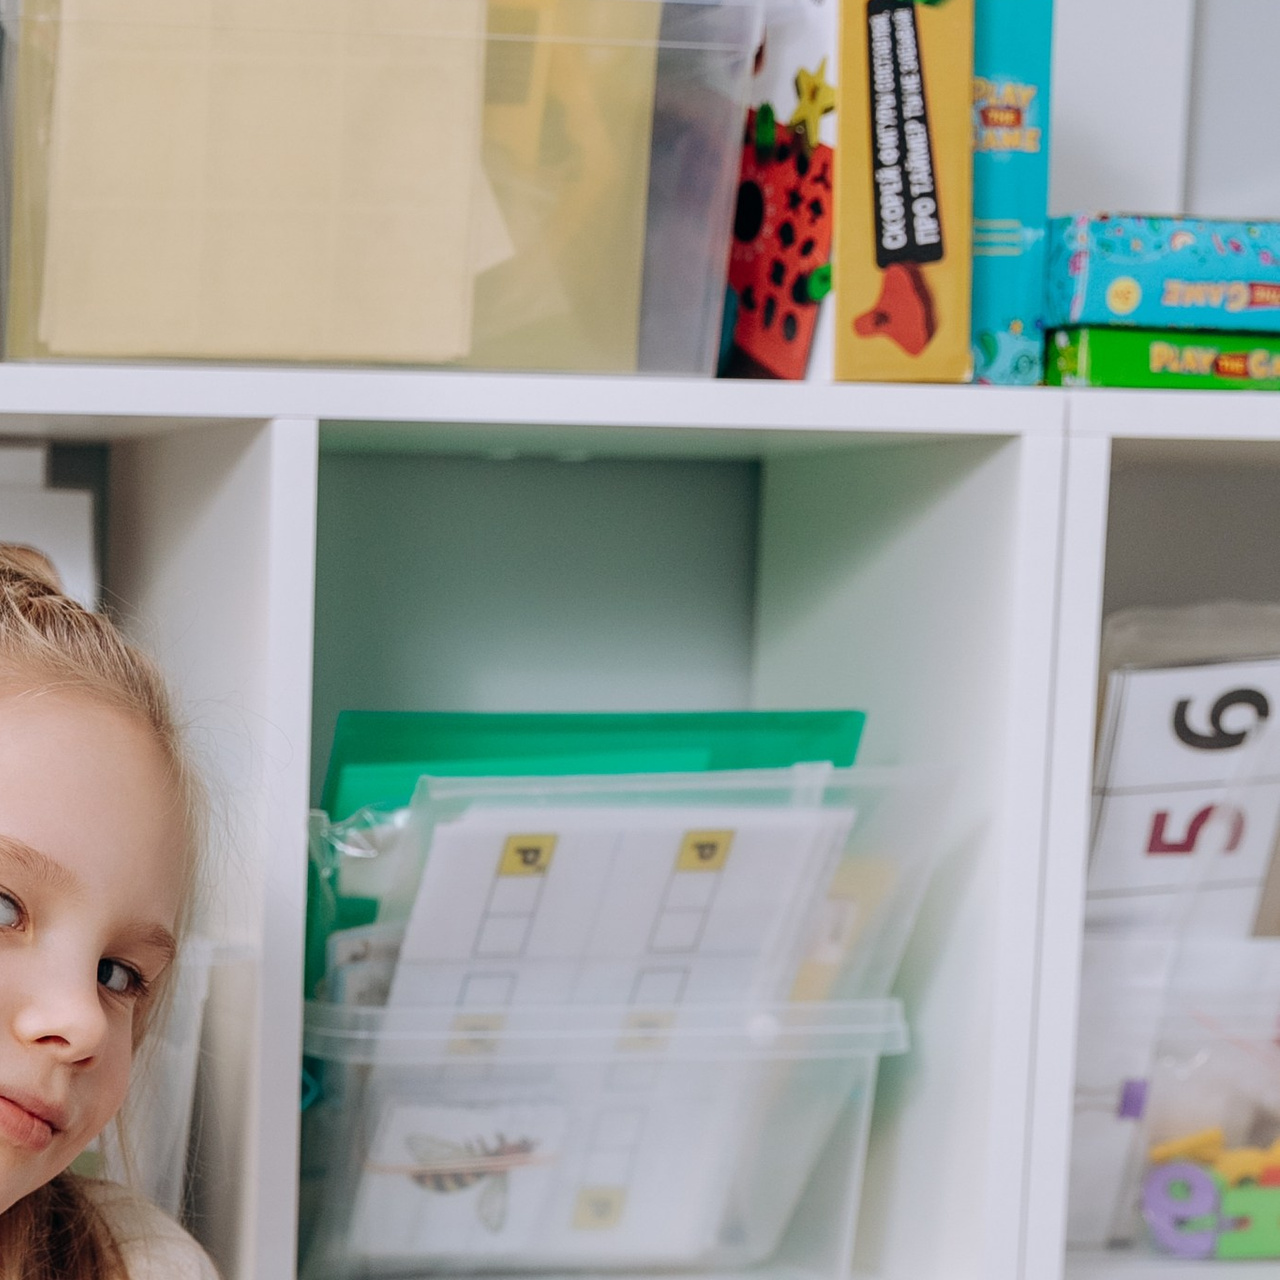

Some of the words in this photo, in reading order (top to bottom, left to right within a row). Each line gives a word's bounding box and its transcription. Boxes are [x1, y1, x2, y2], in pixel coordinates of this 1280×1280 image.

[900, 73, 922, 94] НЕ
[902, 91, 924, 120] ТЫ
[875, 92, 900, 165] ФИГУРЫ
[904, 119, 933, 197] ТАЙМЕР
[876, 165, 907, 250] СКОРЕЙ
[912, 197, 940, 246] ПРО
[1149, 341, 1217, 374] PLAY
[1147, 802, 1245, 854] 5
